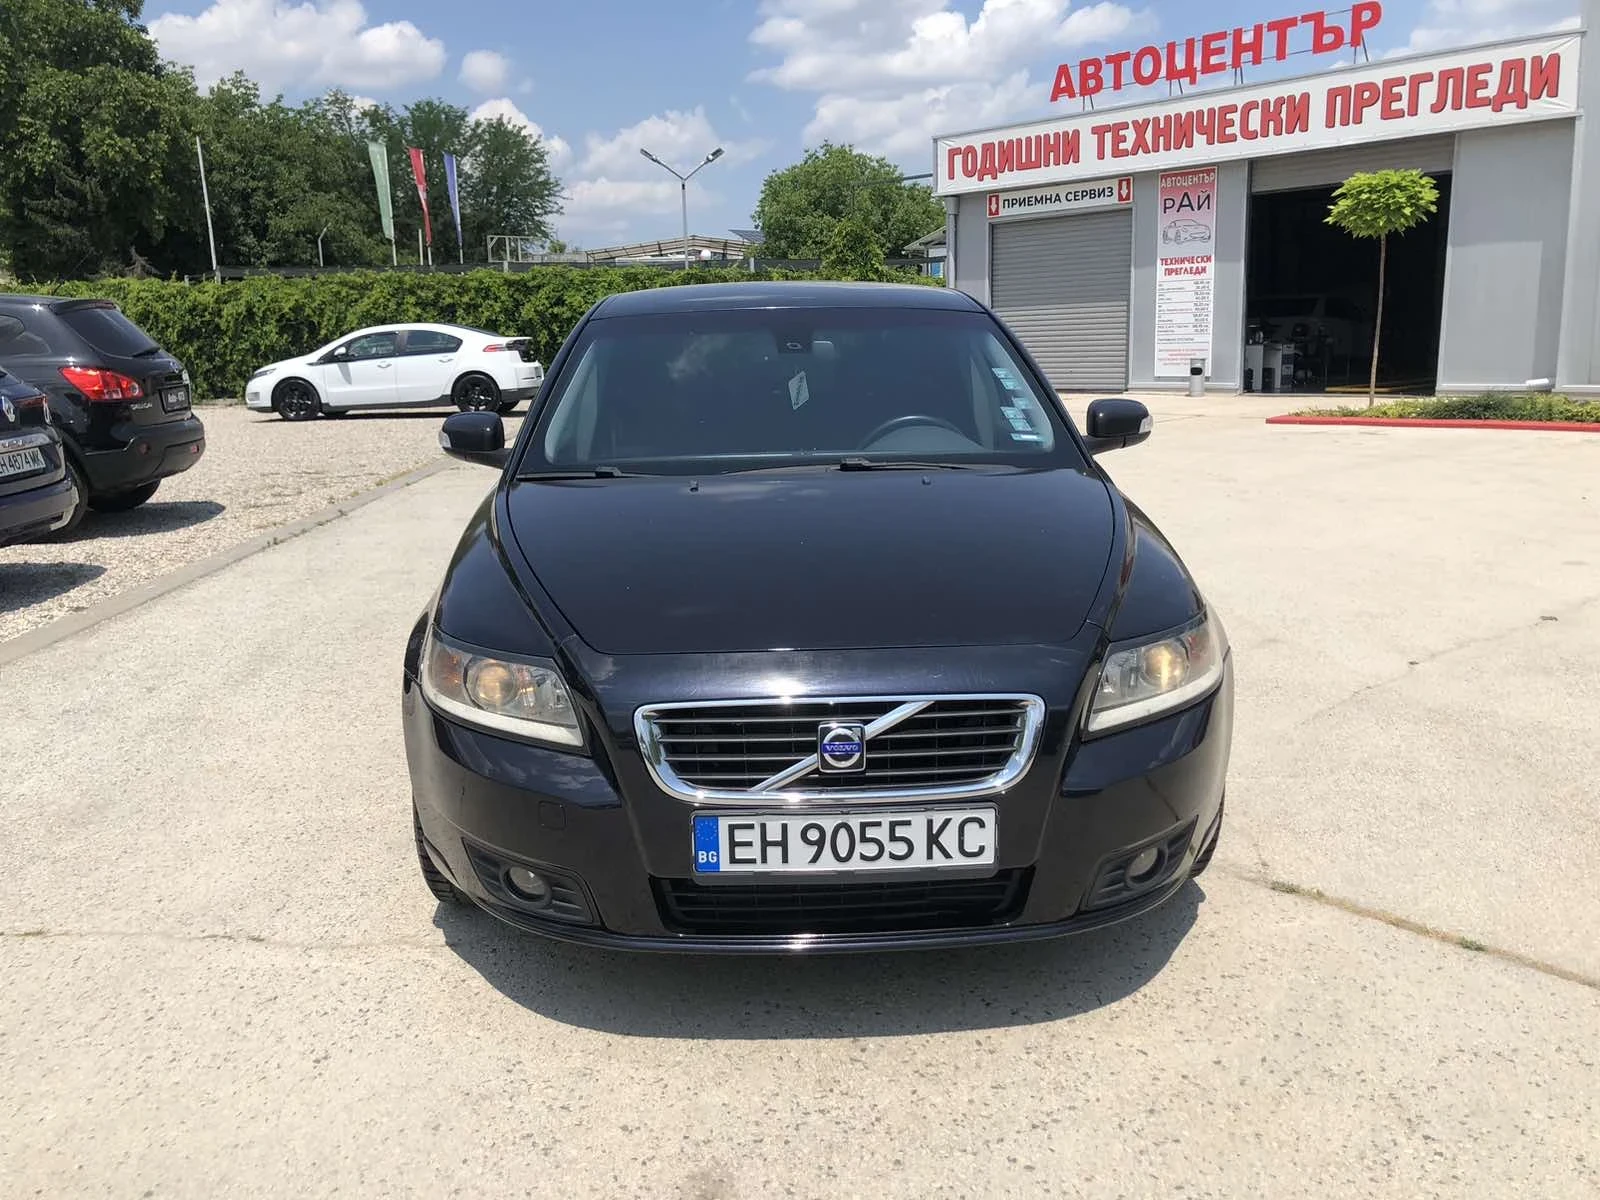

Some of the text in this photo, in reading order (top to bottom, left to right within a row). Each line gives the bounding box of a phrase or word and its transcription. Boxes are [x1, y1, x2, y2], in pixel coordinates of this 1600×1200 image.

[1050, 1, 1382, 102] АВТОЦЕНТЪР
[947, 53, 1560, 182] ГОДИШНИ ТЕХНИЧЕСКИ ПРЕГЛЕДИ
[1160, 172, 1215, 188] АВТОЦЕНТЪР
[1002, 186, 1114, 209] ПРИЕМНА СЕРВИЗ
[1163, 190, 1211, 214] РАЙ
[1160, 255, 1212, 266] ТЕХНИЧЕСКИ
[1164, 265, 1207, 277] ПРЕГЛЕДИ
[825, 744, 858, 752] VOLVO
[727, 816, 985, 864] EH 9055 KC
[698, 850, 718, 863] BG
